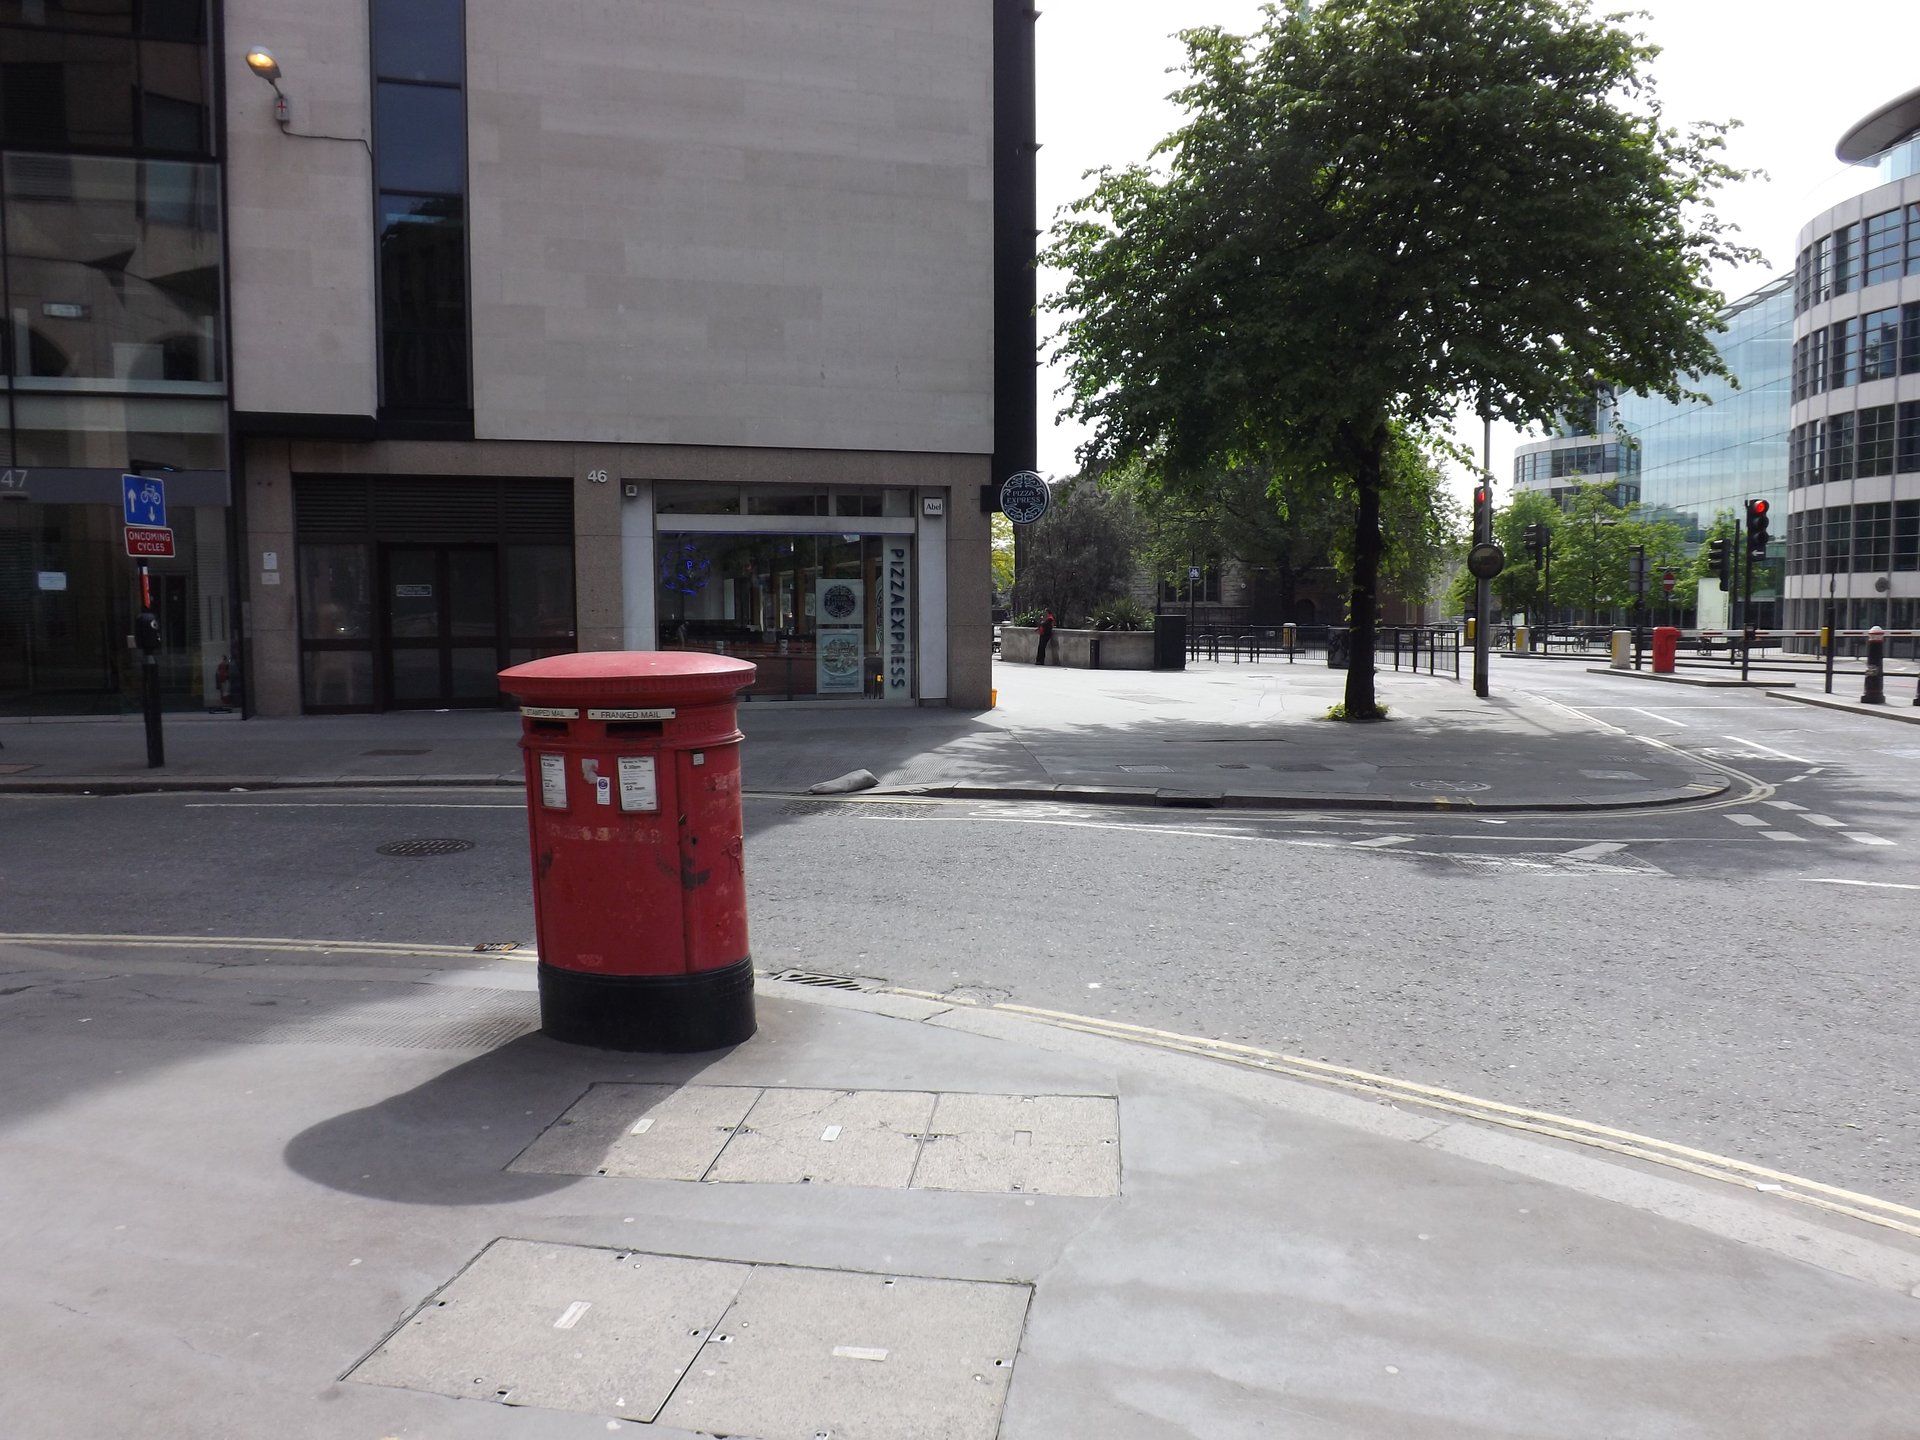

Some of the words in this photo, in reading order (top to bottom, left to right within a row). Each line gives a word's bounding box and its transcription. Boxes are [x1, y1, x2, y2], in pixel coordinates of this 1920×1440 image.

[1, 469, 28, 488] 47
[587, 469, 608, 483] 46
[1006, 496, 1041, 504] EXPRESS
[925, 503, 942, 511] Abel
[128, 531, 171, 542] ONCOMING
[137, 542, 165, 552] CYCLES
[890, 548, 906, 691] PIZZAEXPRESS
[526, 708, 549, 716] STAMPED
[600, 711, 639, 719] FRANKED
